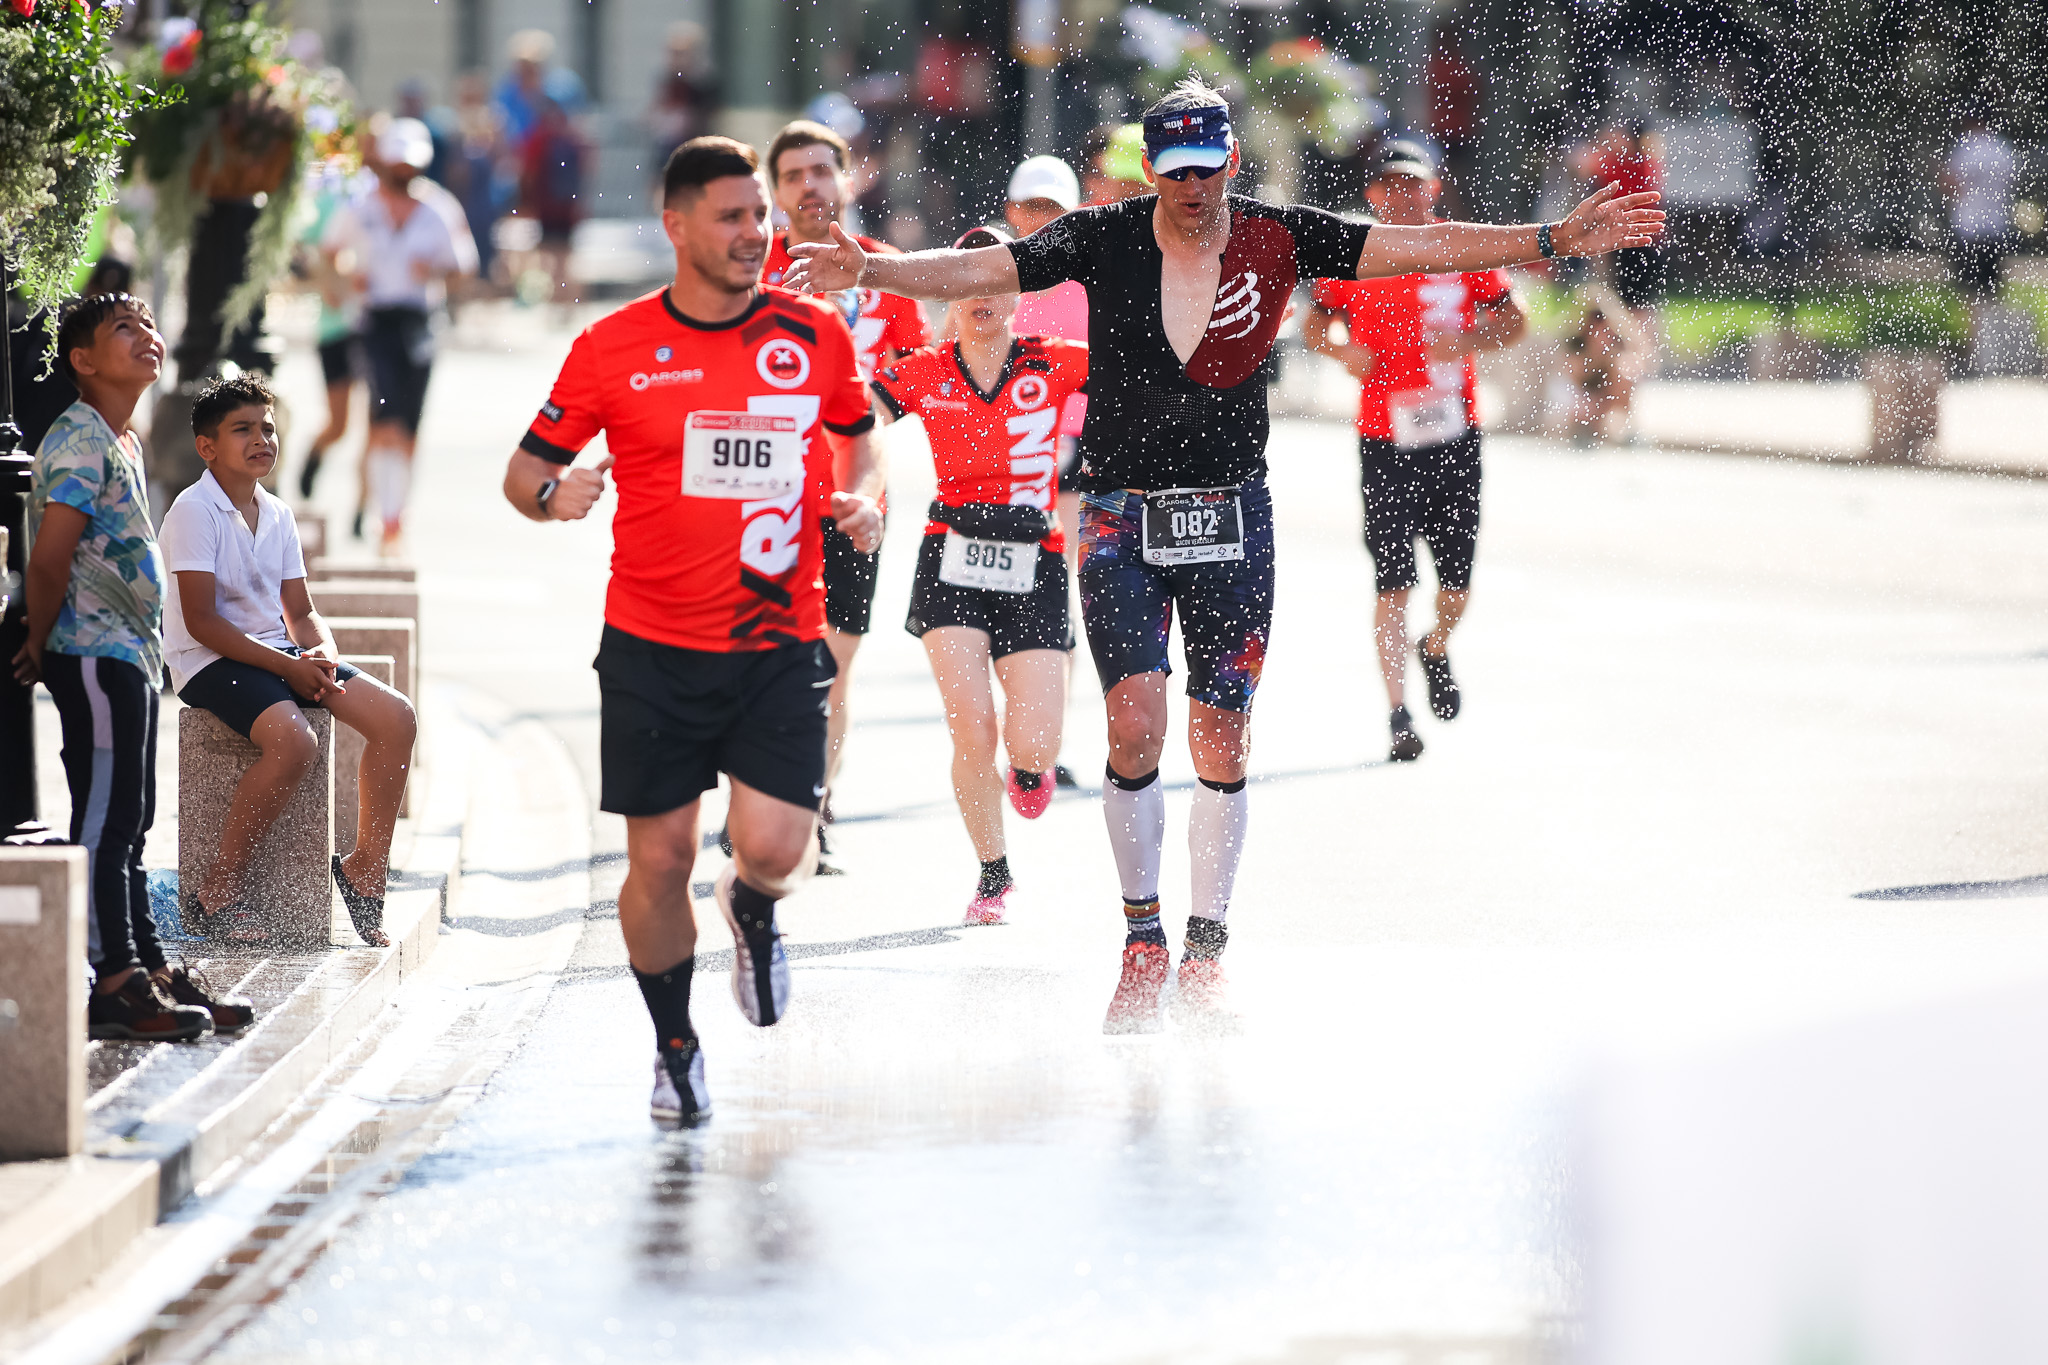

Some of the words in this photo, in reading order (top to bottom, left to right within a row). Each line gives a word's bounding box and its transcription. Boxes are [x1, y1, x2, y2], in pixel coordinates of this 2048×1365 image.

[649, 368, 704, 382] AROBS
[713, 438, 771, 468] 906
[1171, 509, 1218, 538] 082
[966, 543, 1013, 571] 905
